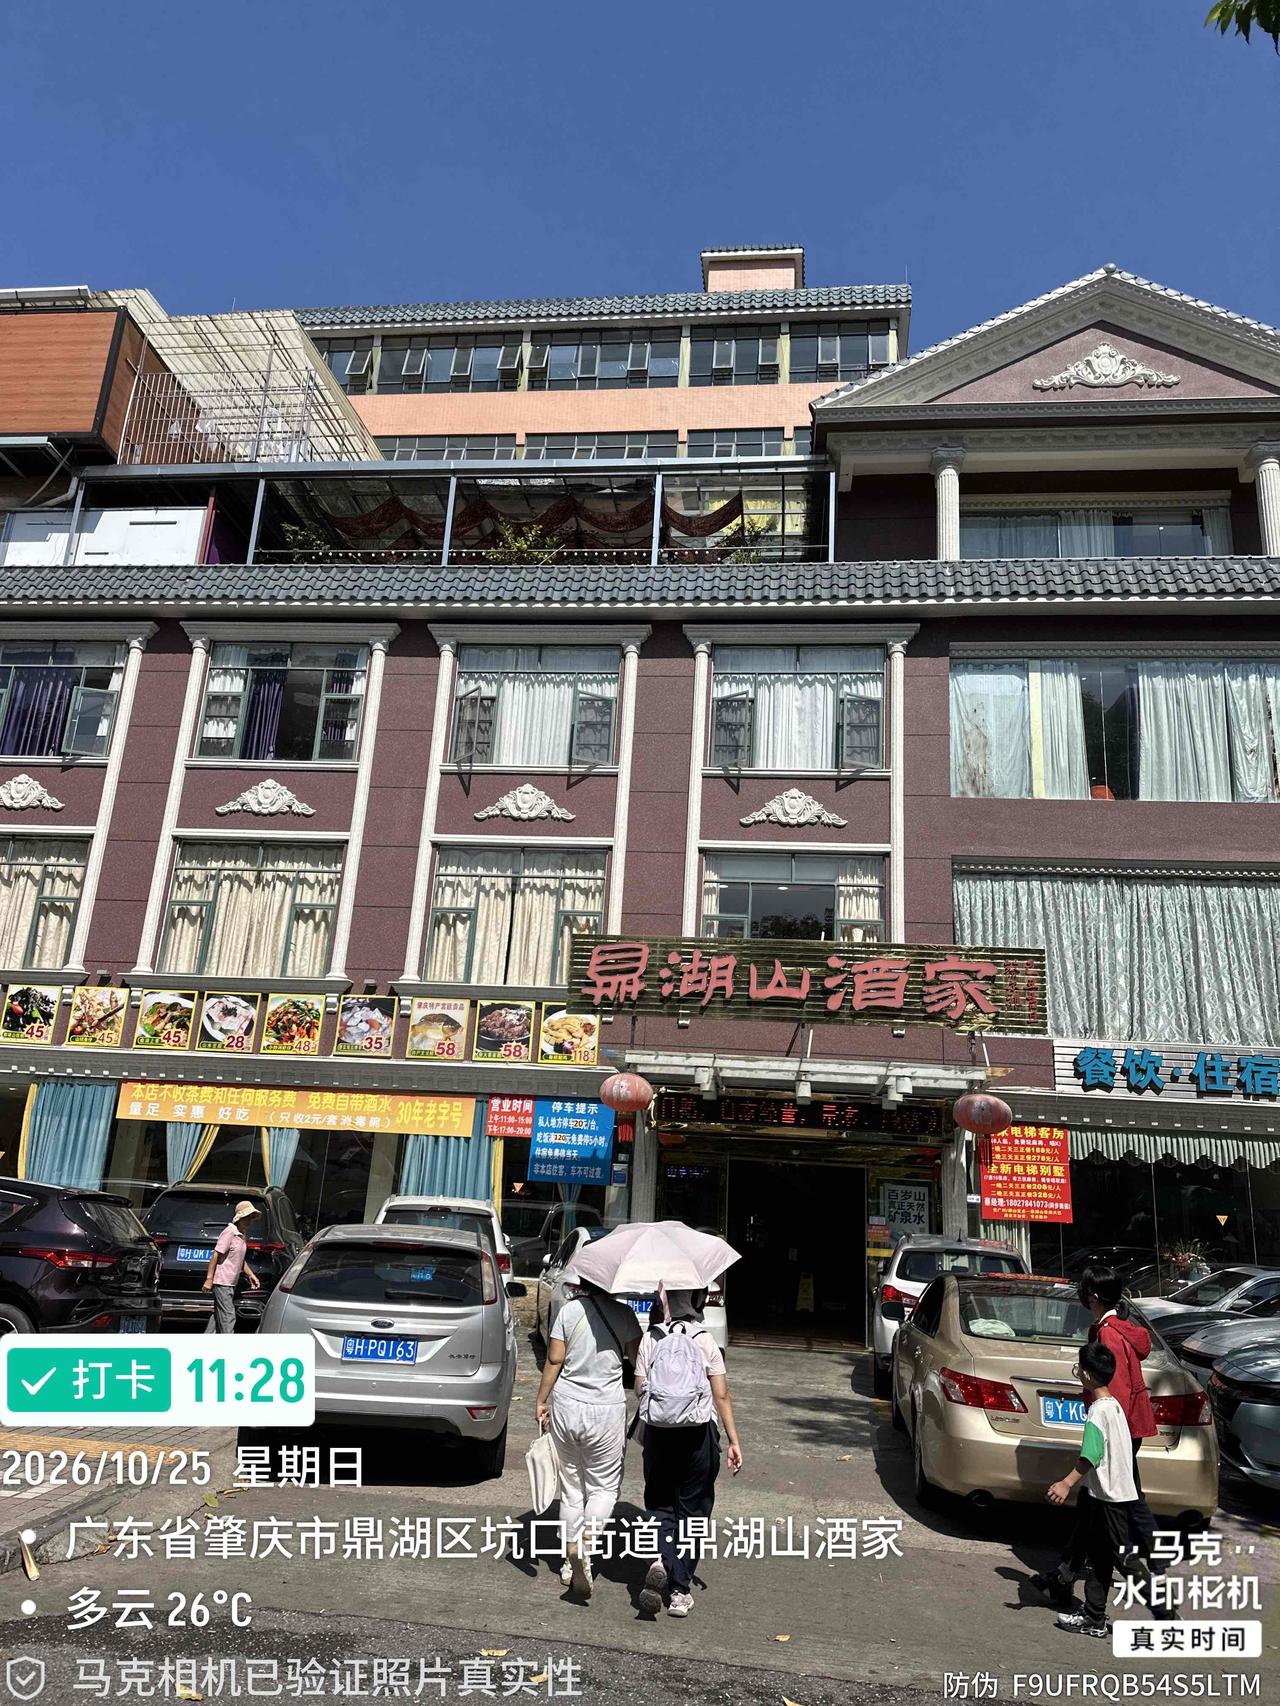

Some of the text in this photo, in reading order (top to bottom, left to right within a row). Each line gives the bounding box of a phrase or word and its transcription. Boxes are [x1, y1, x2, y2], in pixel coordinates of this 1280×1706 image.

[26, 1025, 44, 1038] 45
[98, 1033, 113, 1044] 45
[162, 1030, 181, 1043] 45
[225, 1035, 245, 1048] 28
[295, 1040, 311, 1052] 48
[363, 1036, 383, 1050] 35
[436, 1042, 456, 1056] 58
[503, 1044, 522, 1057] 58
[574, 1050, 590, 1062] 118
[1074, 1046, 1280, 1098] 餐饮·住宿
[131, 1083, 393, 1113] 本店不收茶费和任何服务费 免费自带酒水
[490, 1097, 533, 1113] 营业时间
[128, 1101, 160, 1117] 量足
[172, 1104, 205, 1118] 实惠
[217, 1106, 250, 1121] 好吃
[396, 1098, 464, 1129] 30年老字号
[551, 1101, 599, 1115] 停车提示
[987, 1163, 1065, 1177] 全新电梯别墅
[888, 1188, 926, 1202] 百岁山
[888, 1200, 926, 1212] 真正天然
[888, 1211, 926, 1225] 矿泉水
